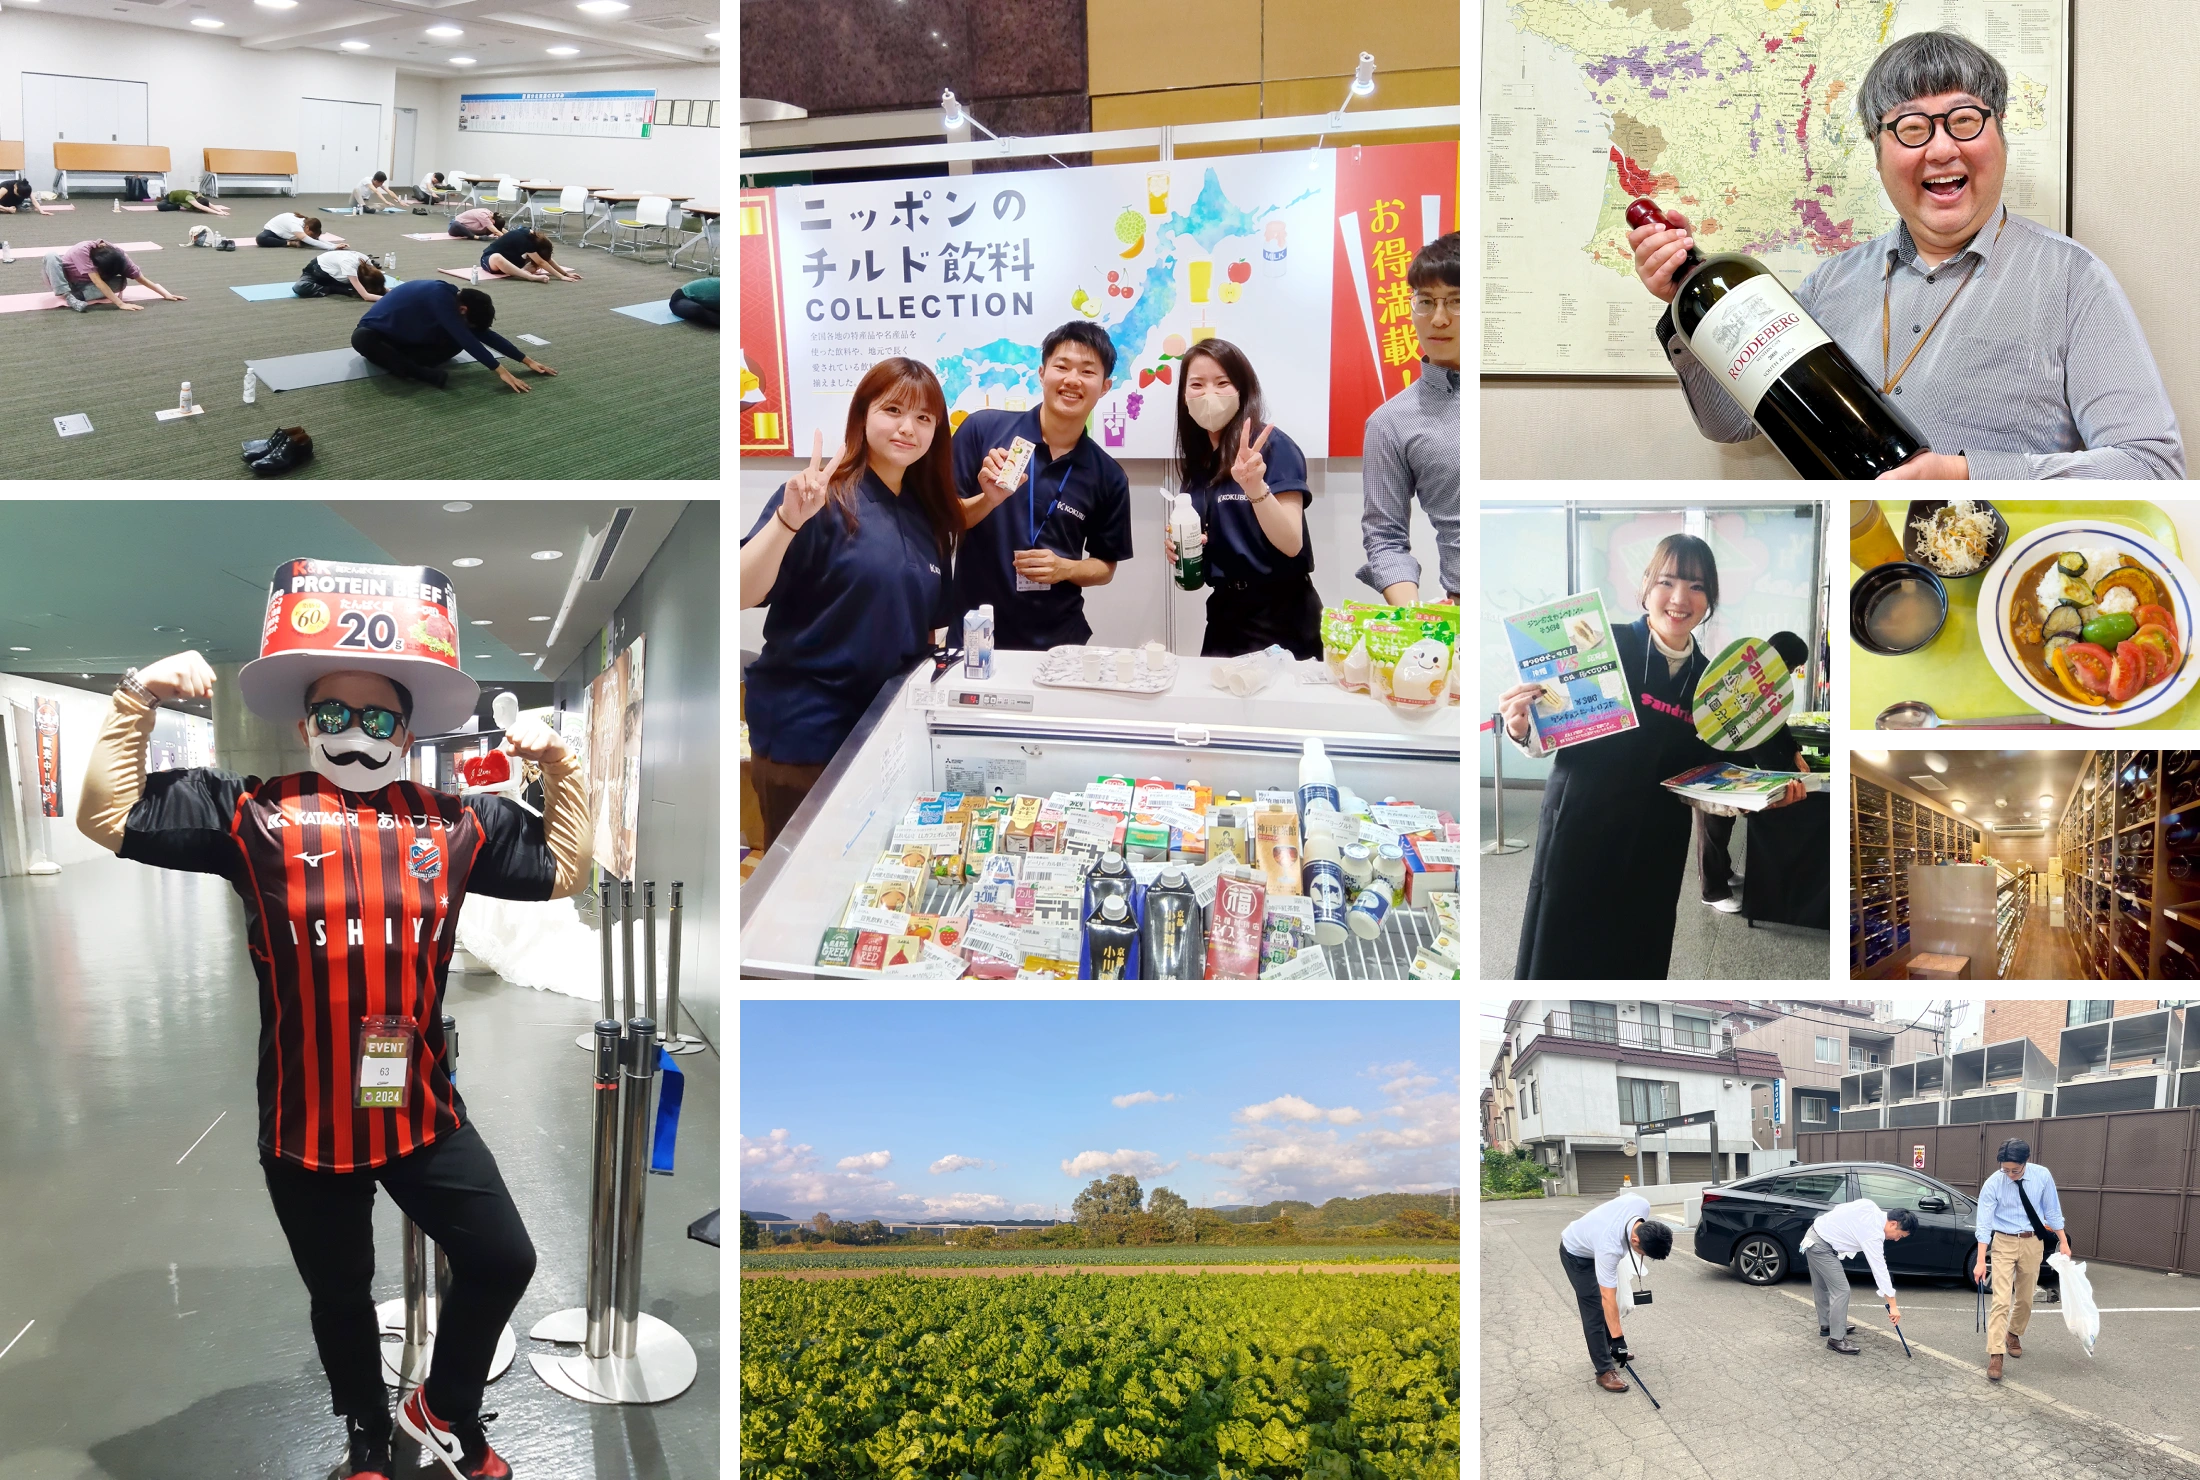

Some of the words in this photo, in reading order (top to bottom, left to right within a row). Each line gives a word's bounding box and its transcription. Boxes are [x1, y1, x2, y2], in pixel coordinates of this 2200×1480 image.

[801, 190, 1026, 232] ニッポンの
[803, 238, 1035, 288] チルド飲料
[1265, 250, 1285, 260] MILK
[806, 292, 1033, 321] COLLECTION
[810, 330, 917, 341] 全国各地の特産品や名産品を
[811, 346, 908, 357] 使った飲料や、地元で長く
[1728, 312, 1800, 380] ROODEBERG
[1757, 345, 1773, 362] WESTERN
[1763, 361, 1779, 377] SOUTH
[1779, 347, 1796, 362] AFRICA
[291, 576, 387, 596] PROTEIN
[393, 581, 442, 603] BEEF
[298, 609, 320, 628] 60
[338, 611, 396, 650] 20
[1556, 656, 1579, 673] VS
[1741, 645, 1783, 716] Sandria
[377, 812, 455, 833] あいプラン
[978, 828, 988, 850] 豆乳
[1227, 887, 1251, 914] 福
[860, 915, 883, 923] 豆乳飲料
[289, 918, 446, 946] ISHIYA
[1213, 923, 1258, 942] アイスティー
[821, 947, 852, 957] GREEN
[861, 952, 878, 962] RED
[998, 951, 1013, 961] 300
[1116, 947, 1125, 967] 京都
[368, 1042, 404, 1053] EVENT
[380, 1067, 390, 1076] 63
[375, 1091, 400, 1102] 2024
